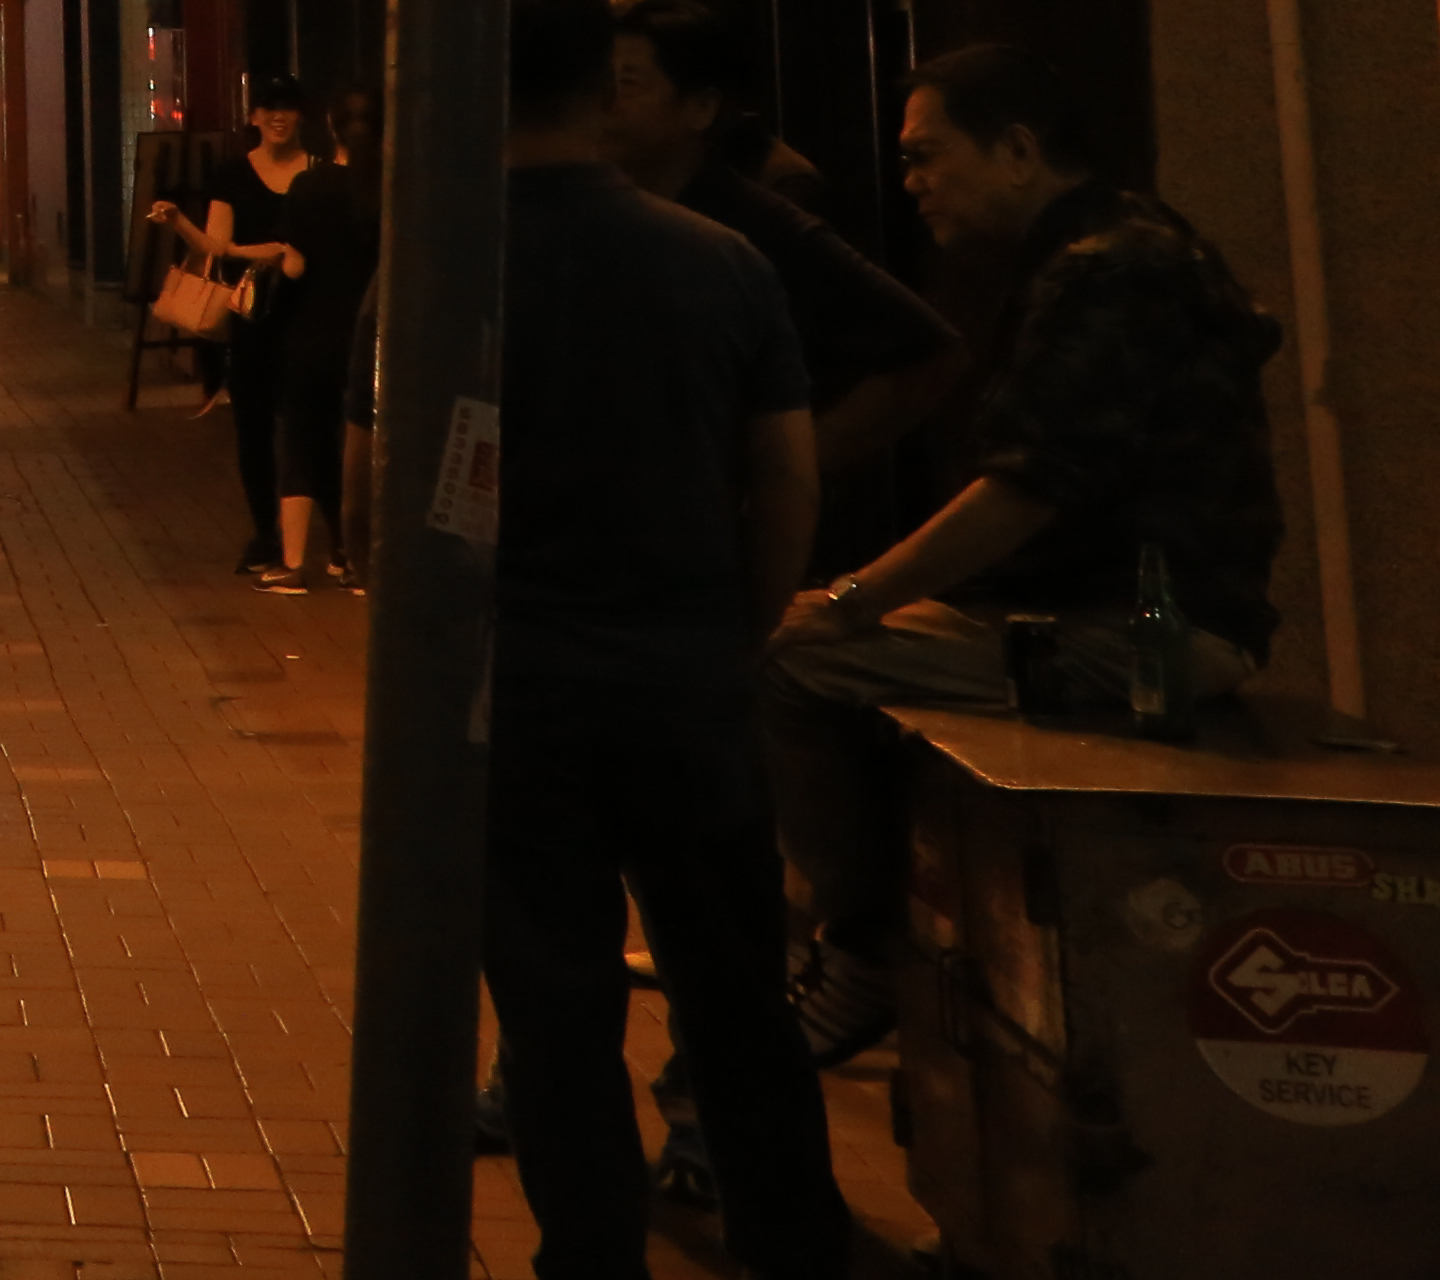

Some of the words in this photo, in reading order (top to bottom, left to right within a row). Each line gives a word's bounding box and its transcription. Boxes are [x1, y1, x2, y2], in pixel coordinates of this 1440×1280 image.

[1243, 851, 1357, 880] ABUS
[1285, 1052, 1339, 1078] KEY
[1259, 1078, 1373, 1110] SERVICE
